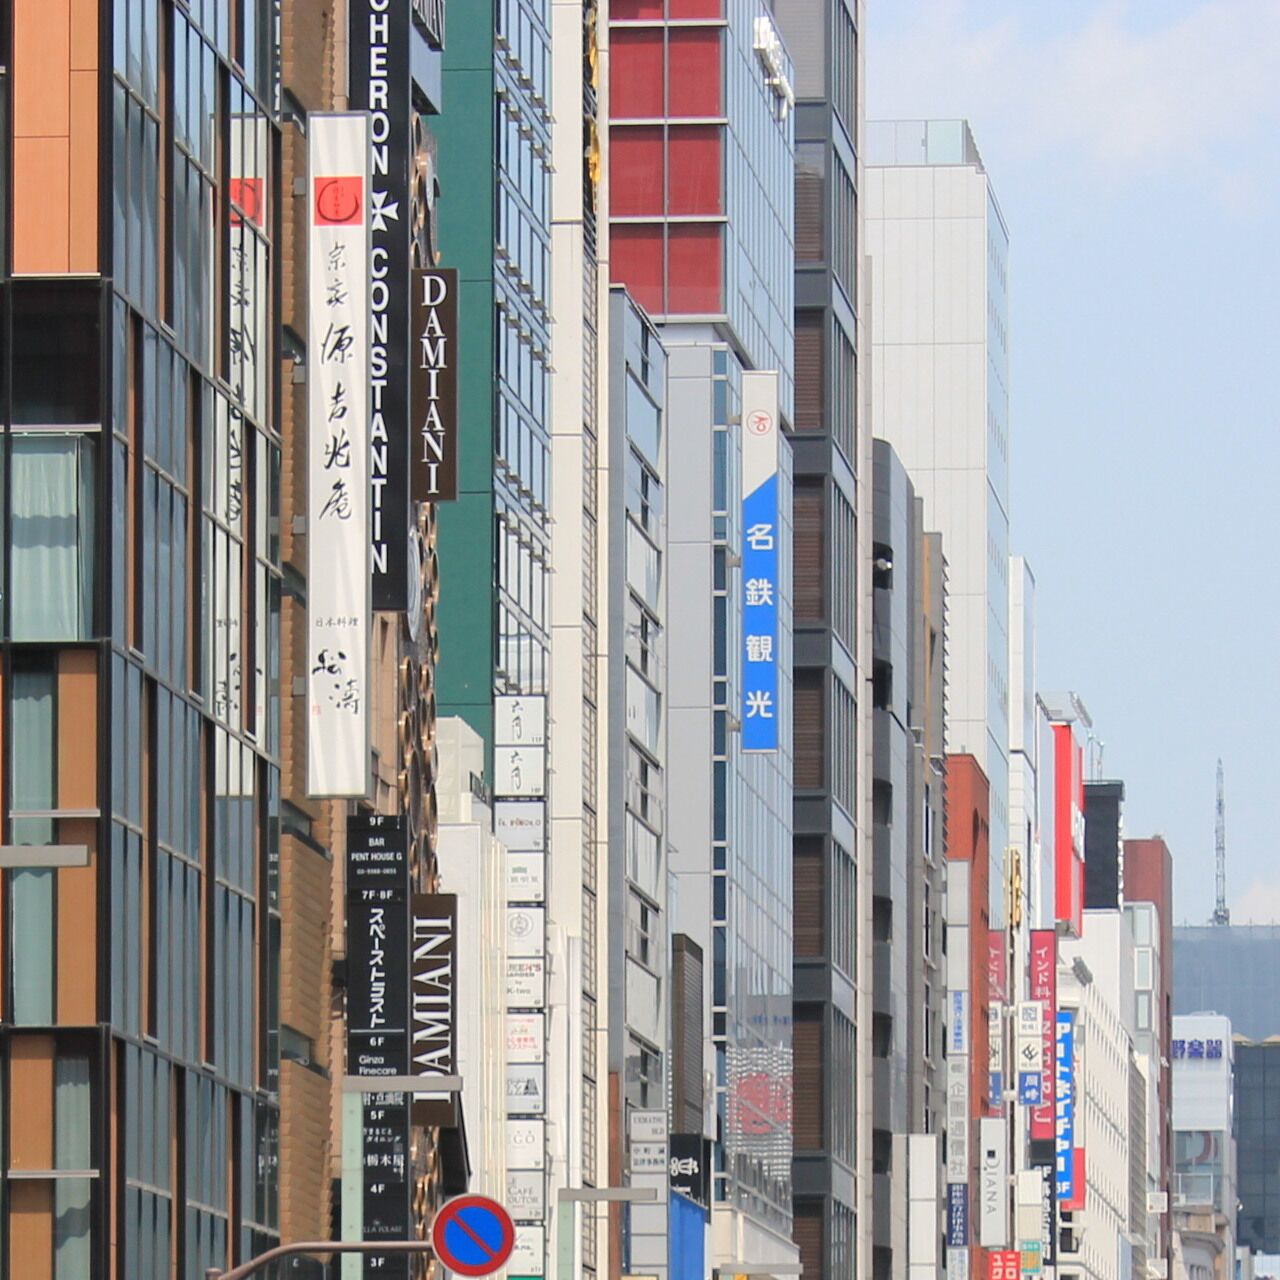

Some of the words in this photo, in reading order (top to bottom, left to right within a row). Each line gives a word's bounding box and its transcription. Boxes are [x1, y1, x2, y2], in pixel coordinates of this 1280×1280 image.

[420, 275, 448, 494] DAMIANI
[370, 247, 390, 575] CONSTANTIN
[746, 524, 774, 719] 名鉄観光
[369, 817, 385, 826] 9F
[368, 838, 385, 847] BAR
[351, 852, 369, 862] PENT
[370, 852, 395, 862] HOUSE
[368, 907, 386, 1029] スペーストラスト
[370, 1037, 385, 1046] 6F
[358, 1054, 385, 1065] Ginza
[358, 1066, 398, 1076] Finecare
[370, 1110, 385, 1120] 5F
[370, 1184, 385, 1194] 4F
[984, 1154, 1001, 1215] DIANA
[370, 1258, 385, 1267] 3F
